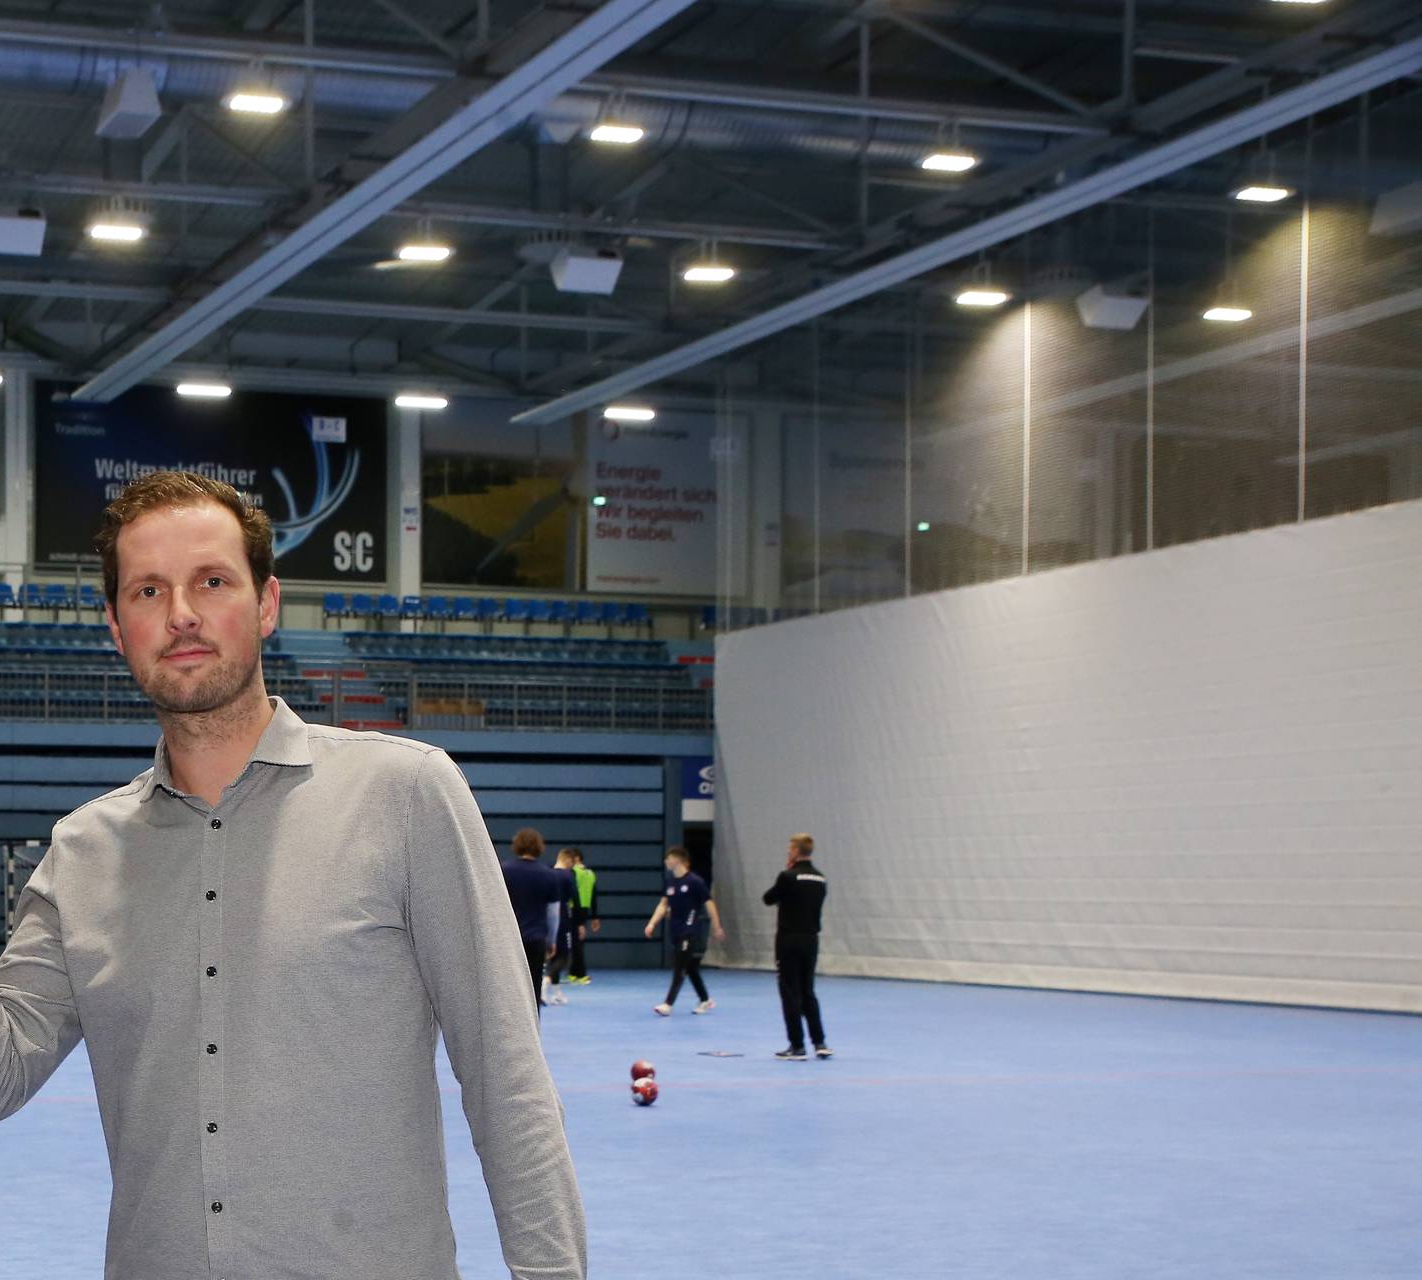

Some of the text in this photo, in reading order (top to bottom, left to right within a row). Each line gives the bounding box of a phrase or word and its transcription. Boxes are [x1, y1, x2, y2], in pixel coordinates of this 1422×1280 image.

[596, 461, 662, 483] Energie
[627, 503, 704, 524] begleiten
[596, 522, 622, 540] Sie
[334, 531, 374, 572] SC
